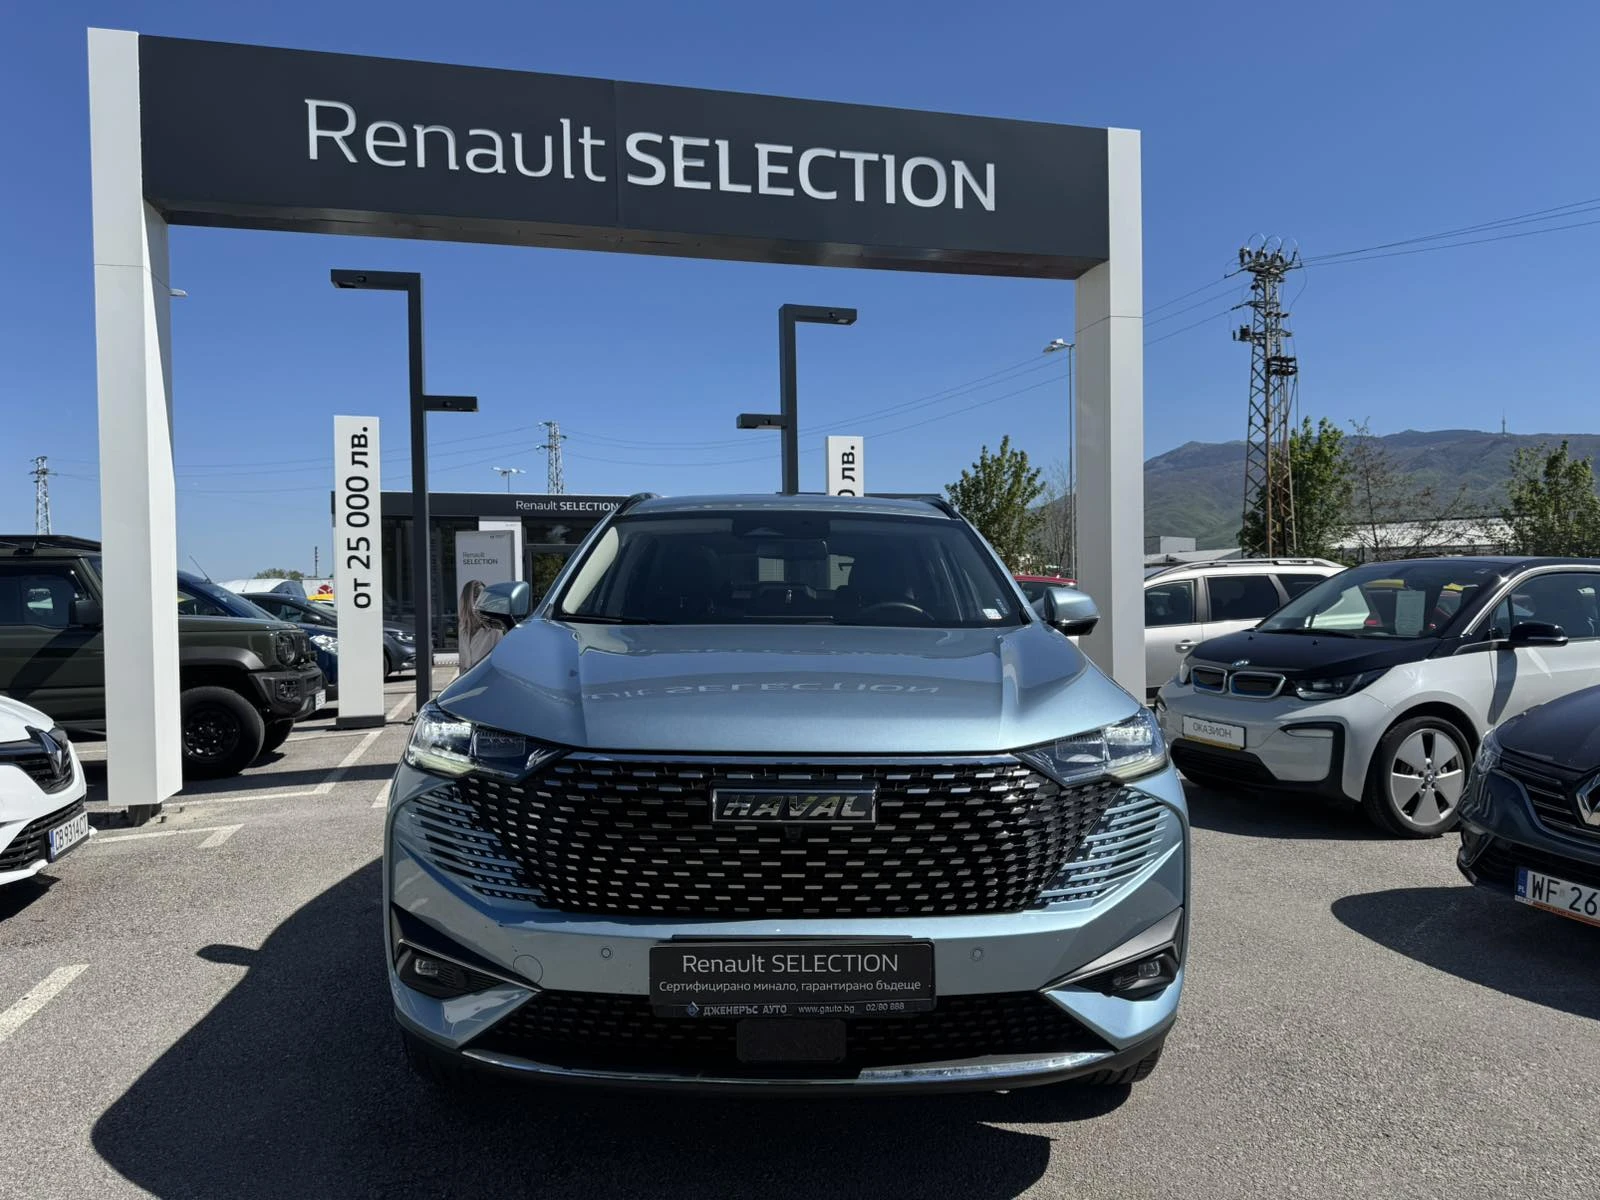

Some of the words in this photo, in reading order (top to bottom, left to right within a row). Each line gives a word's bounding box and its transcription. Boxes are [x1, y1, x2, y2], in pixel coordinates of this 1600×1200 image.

[304, 98, 607, 183] Renault
[625, 131, 996, 212] SELECTION
[350, 426, 369, 469] лв.
[841, 445, 856, 483] лв.
[345, 475, 370, 528] 000
[515, 500, 558, 511] Renault
[559, 501, 621, 512] SELECTION
[346, 536, 371, 570] 25
[353, 577, 371, 609] от
[1192, 722, 1232, 738] ОКАЗИОН
[722, 795, 867, 817] HAVAL
[1532, 873, 1561, 904] WF
[682, 953, 766, 973] Renault
[771, 953, 898, 973] SELECTION
[658, 980, 751, 994] Сертифицирано
[753, 982, 799, 993] минало,
[801, 982, 874, 993] гарантирано
[875, 979, 921, 992] бъдеще
[703, 1005, 759, 1016] ДЖЕНЕРЪС
[762, 1004, 788, 1015] АУТО
[798, 1003, 855, 1015] www.gauto.bg
